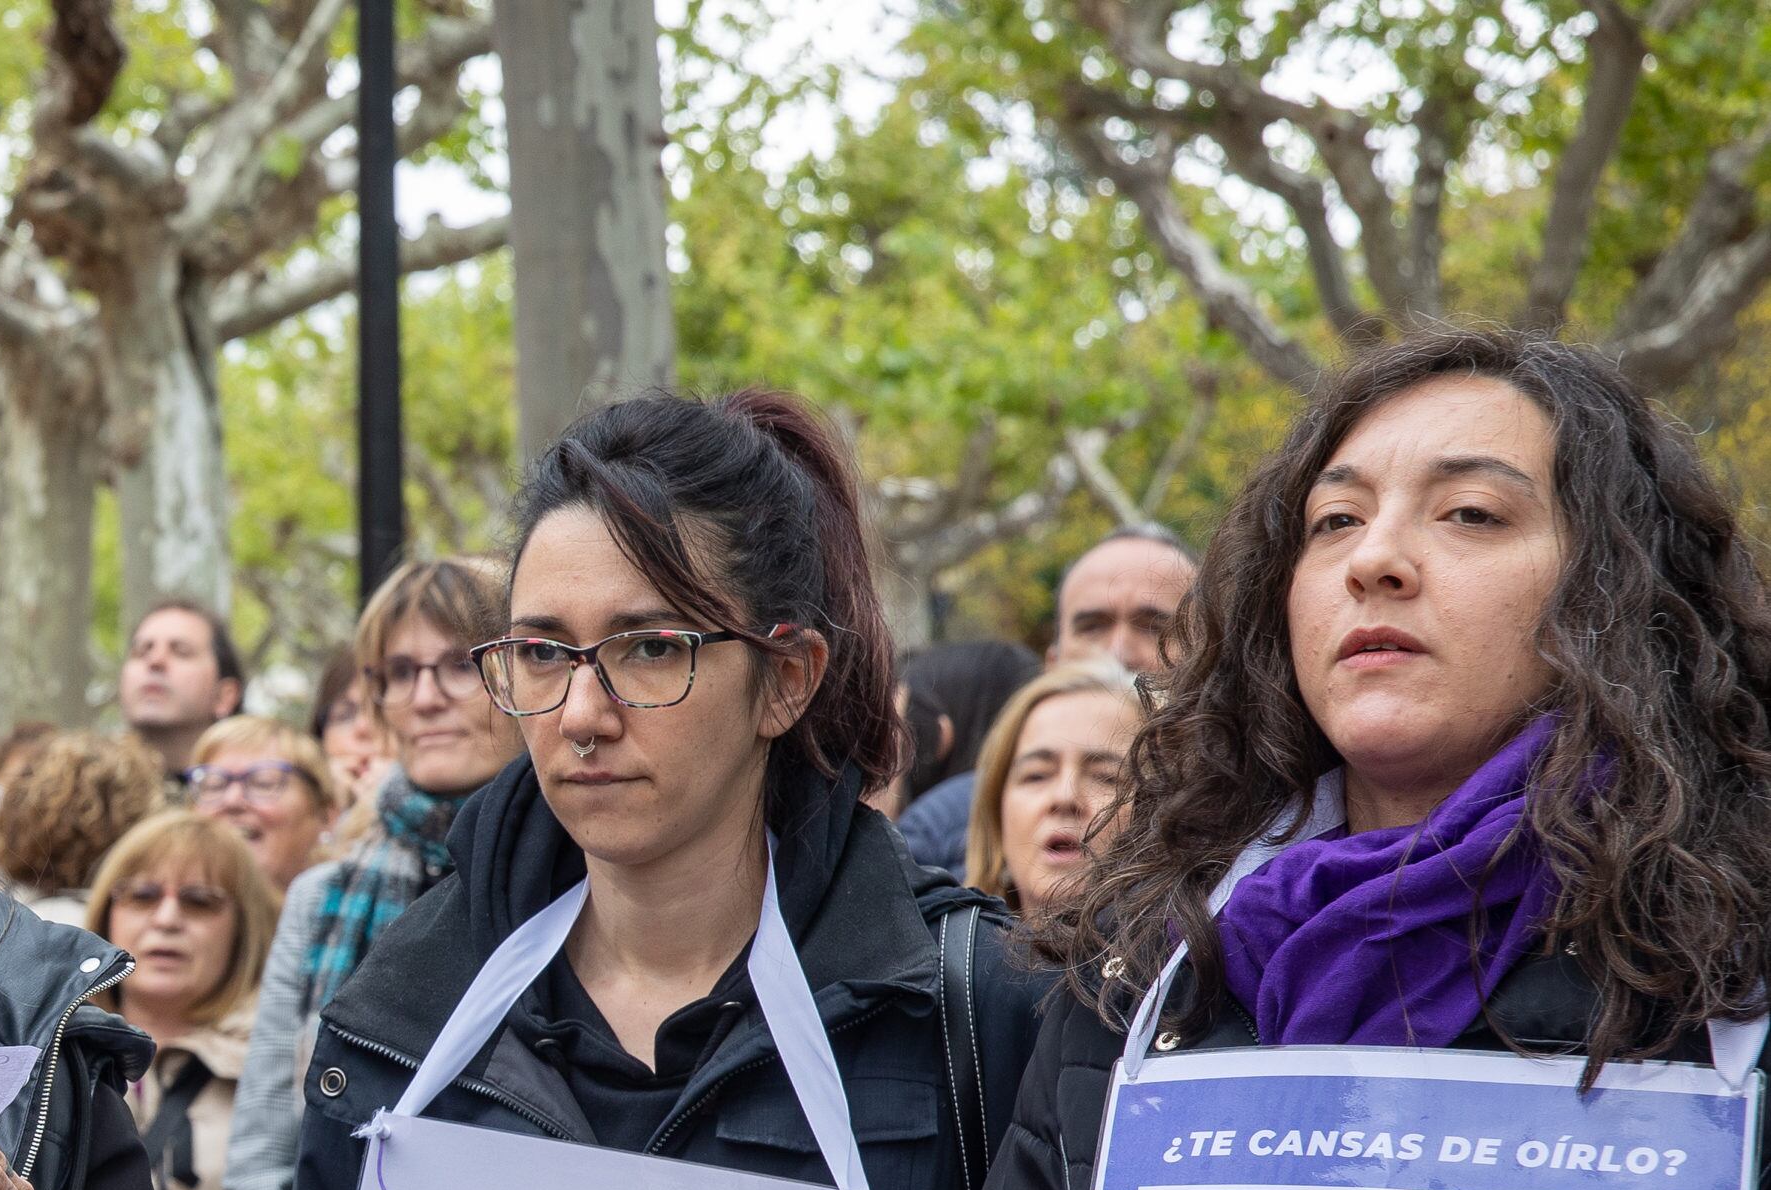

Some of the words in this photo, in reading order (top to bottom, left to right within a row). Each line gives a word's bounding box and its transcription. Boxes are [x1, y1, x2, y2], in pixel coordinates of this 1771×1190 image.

[1163, 1129, 1233, 1164] ¿TE
[1248, 1129, 1425, 1163] CANSAS
[1438, 1135, 1499, 1166] DE
[1515, 1134, 1688, 1178] OÍRLO?
